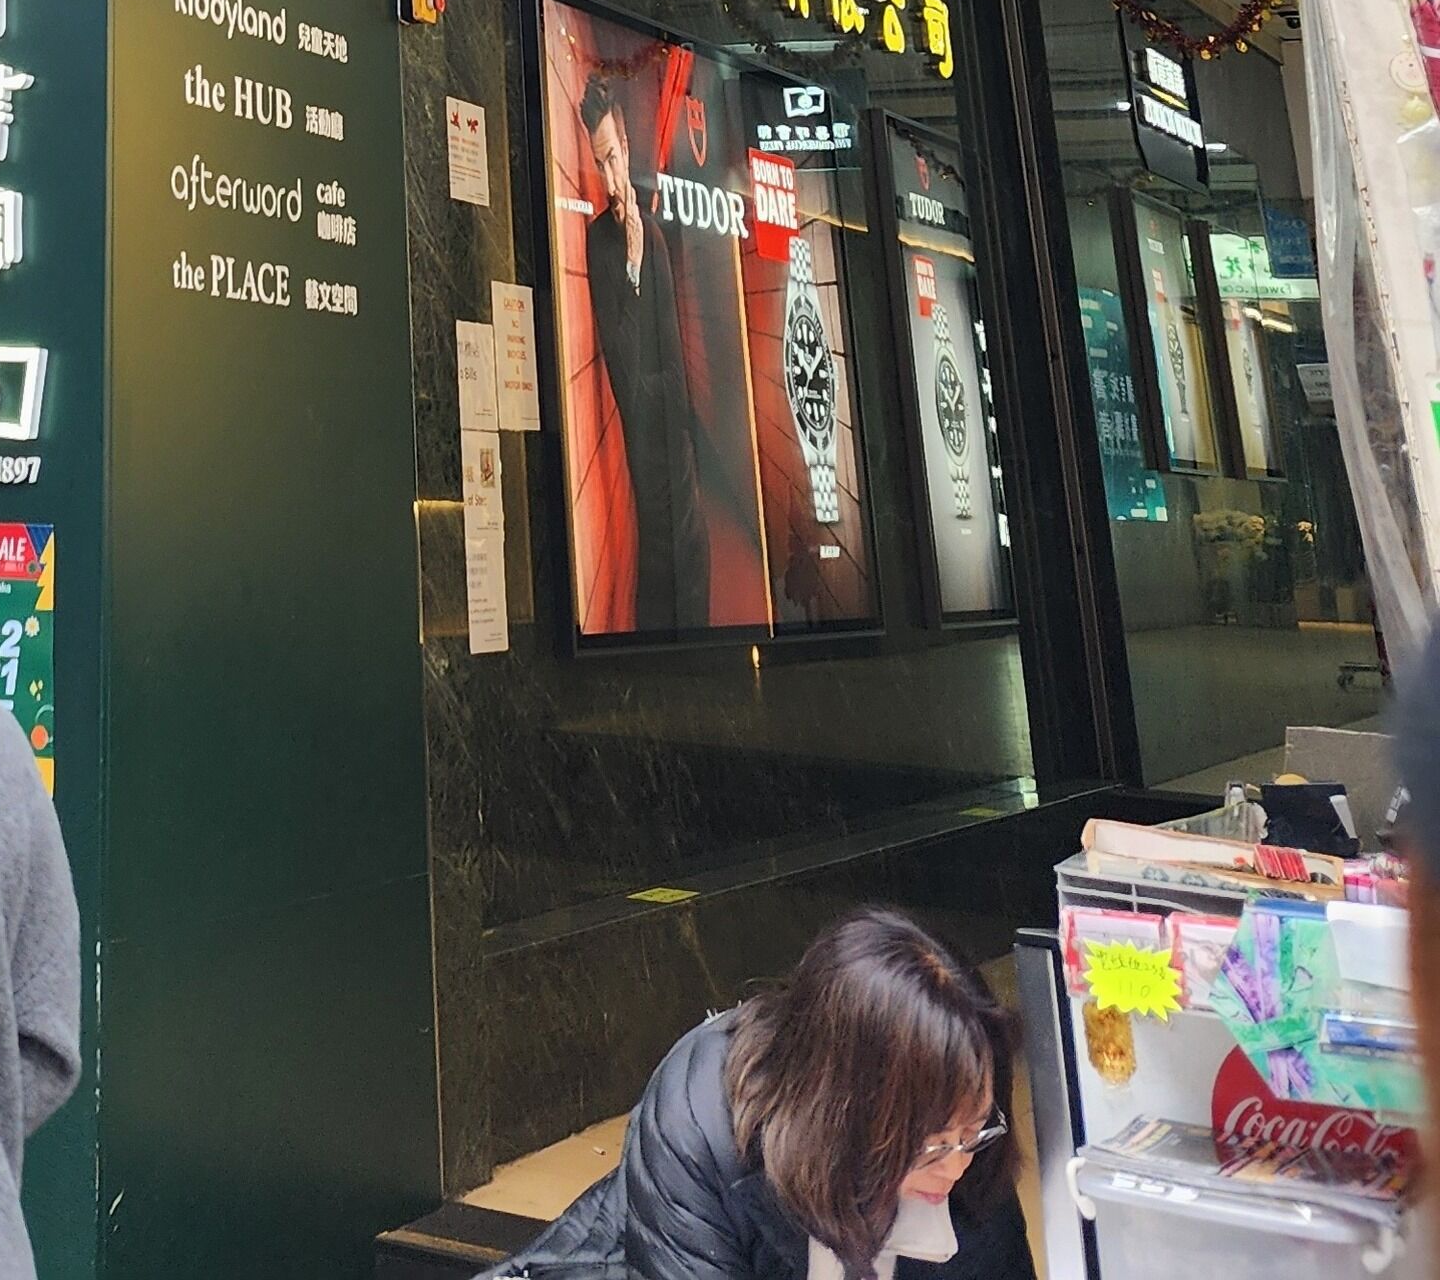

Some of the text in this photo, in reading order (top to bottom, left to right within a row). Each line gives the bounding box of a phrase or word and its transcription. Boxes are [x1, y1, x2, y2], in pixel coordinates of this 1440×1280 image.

[183, 63, 226, 113] the
[233, 75, 294, 130] HUB
[170, 153, 347, 223] afterword cafe
[656, 171, 751, 240] TUDOR
[753, 183, 799, 230] DARE
[907, 191, 946, 227] TUDOR
[316, 209, 358, 247] 咖啡店
[172, 250, 206, 292] the
[210, 253, 292, 308] PLACE
